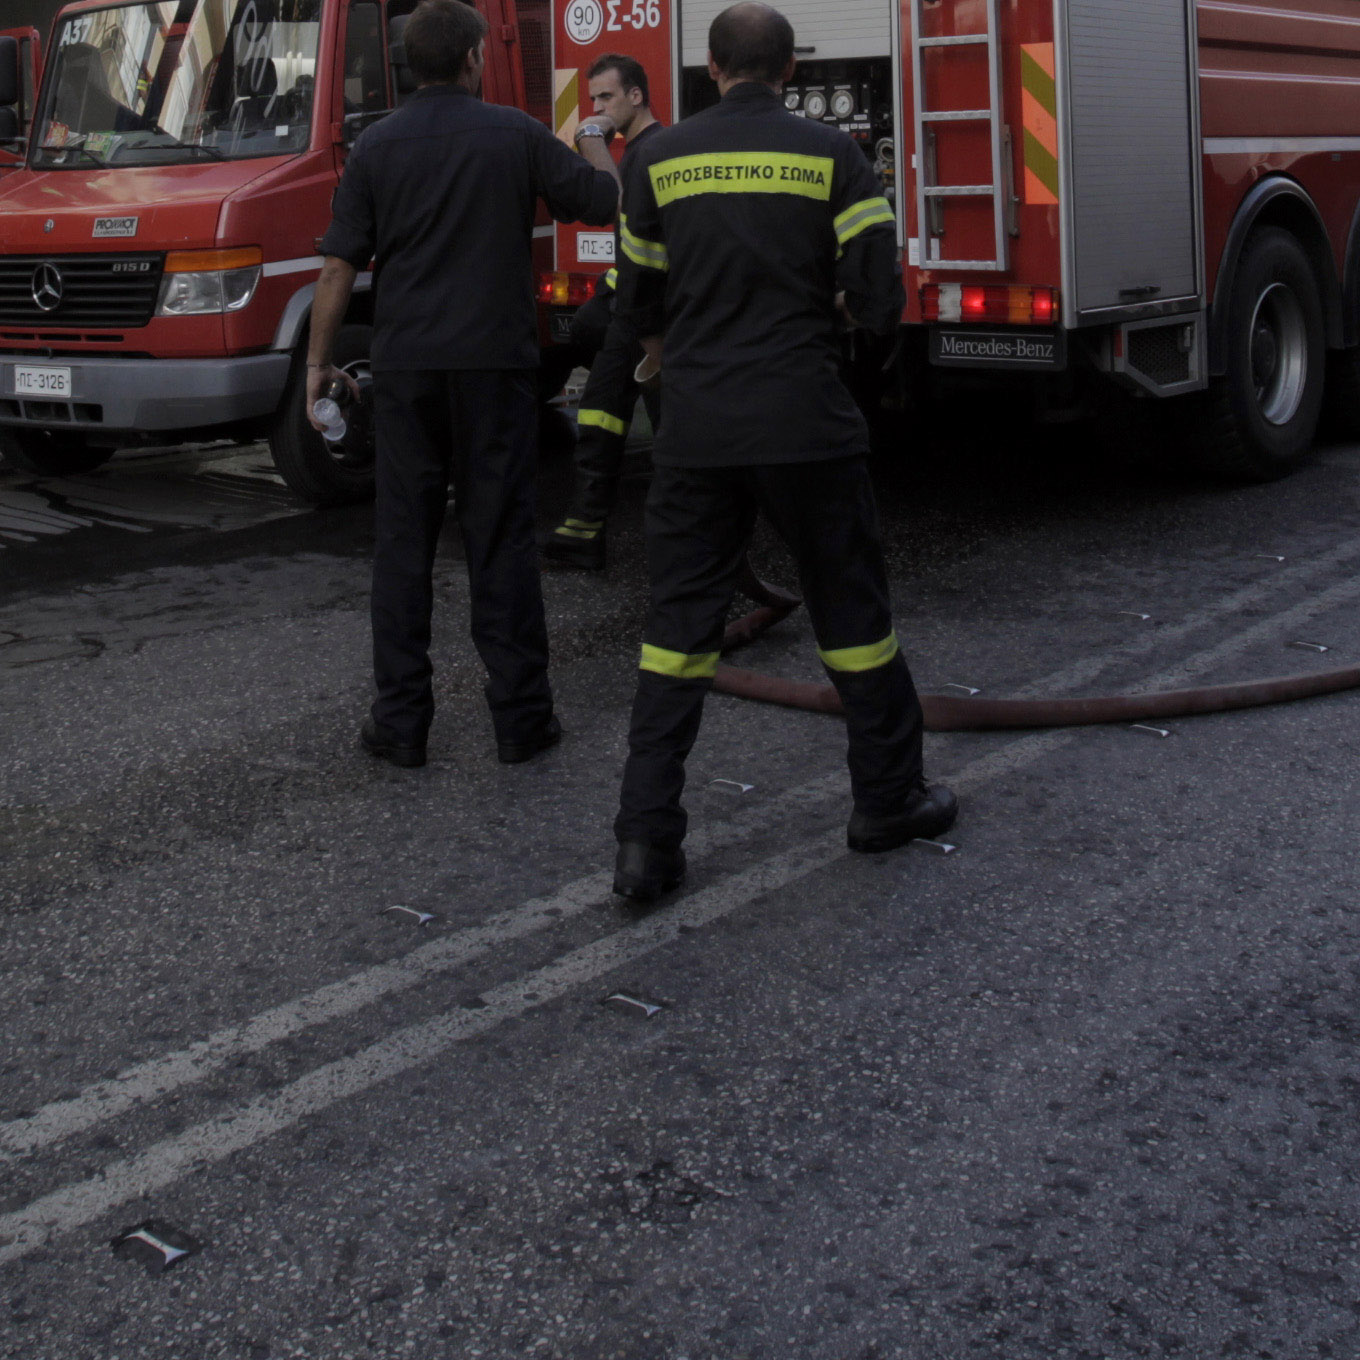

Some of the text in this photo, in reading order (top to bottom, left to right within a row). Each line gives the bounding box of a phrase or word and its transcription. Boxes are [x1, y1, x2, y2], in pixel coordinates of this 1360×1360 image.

[573, 5, 594, 25] 90
[60, 17, 92, 47] A37
[578, 28, 591, 36] km
[656, 165, 825, 192] ΠΥΡΟΣΒΕΣΤΙΚΟ ΣΩΜΑ
[582, 240, 614, 255] ΠΣ-3
[113, 262, 150, 272] 815 D
[941, 336, 1054, 358] Mercedes-Benz
[19, 372, 65, 390] ΠΣ-3126
